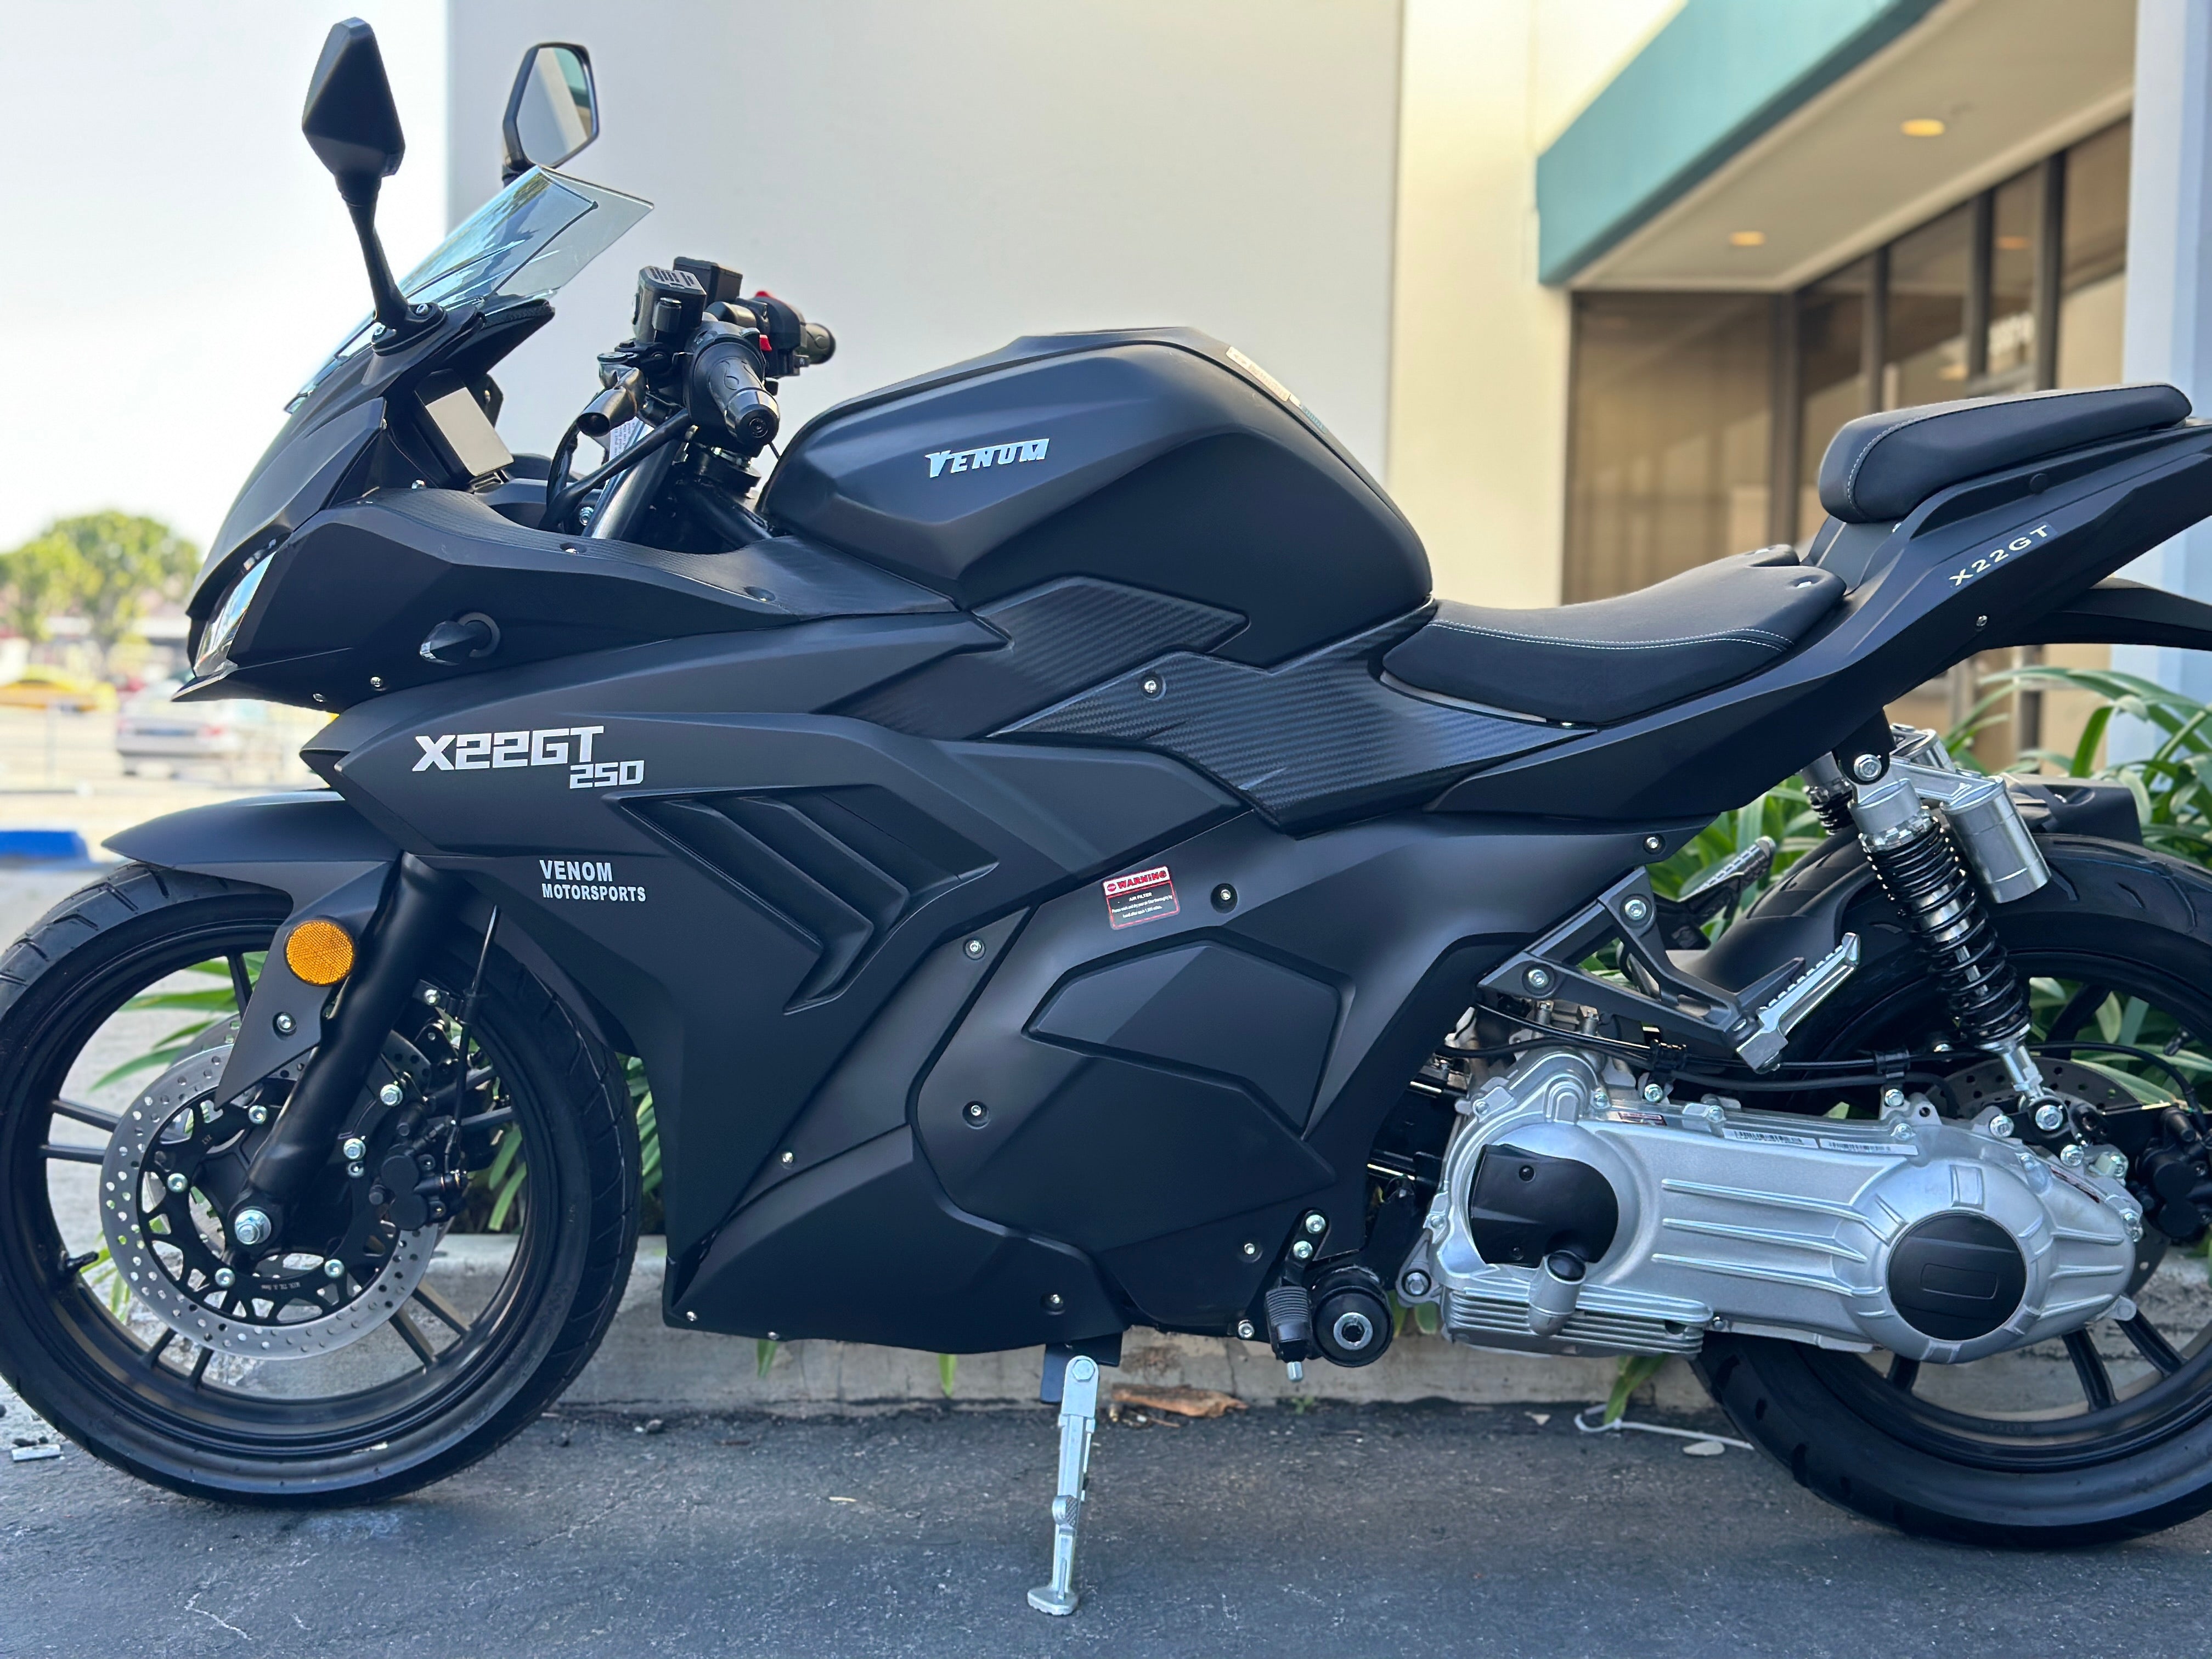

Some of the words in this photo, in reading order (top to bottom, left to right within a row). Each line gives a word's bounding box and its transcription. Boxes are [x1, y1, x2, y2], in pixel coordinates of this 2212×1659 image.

[1949, 525, 2048, 586] X22GT
[412, 726, 604, 771] X22GT
[570, 760, 645, 789] 250
[539, 860, 613, 882] VENOM
[1117, 870, 1167, 889] WARNING
[542, 883, 646, 902] MOTORSPORTS
